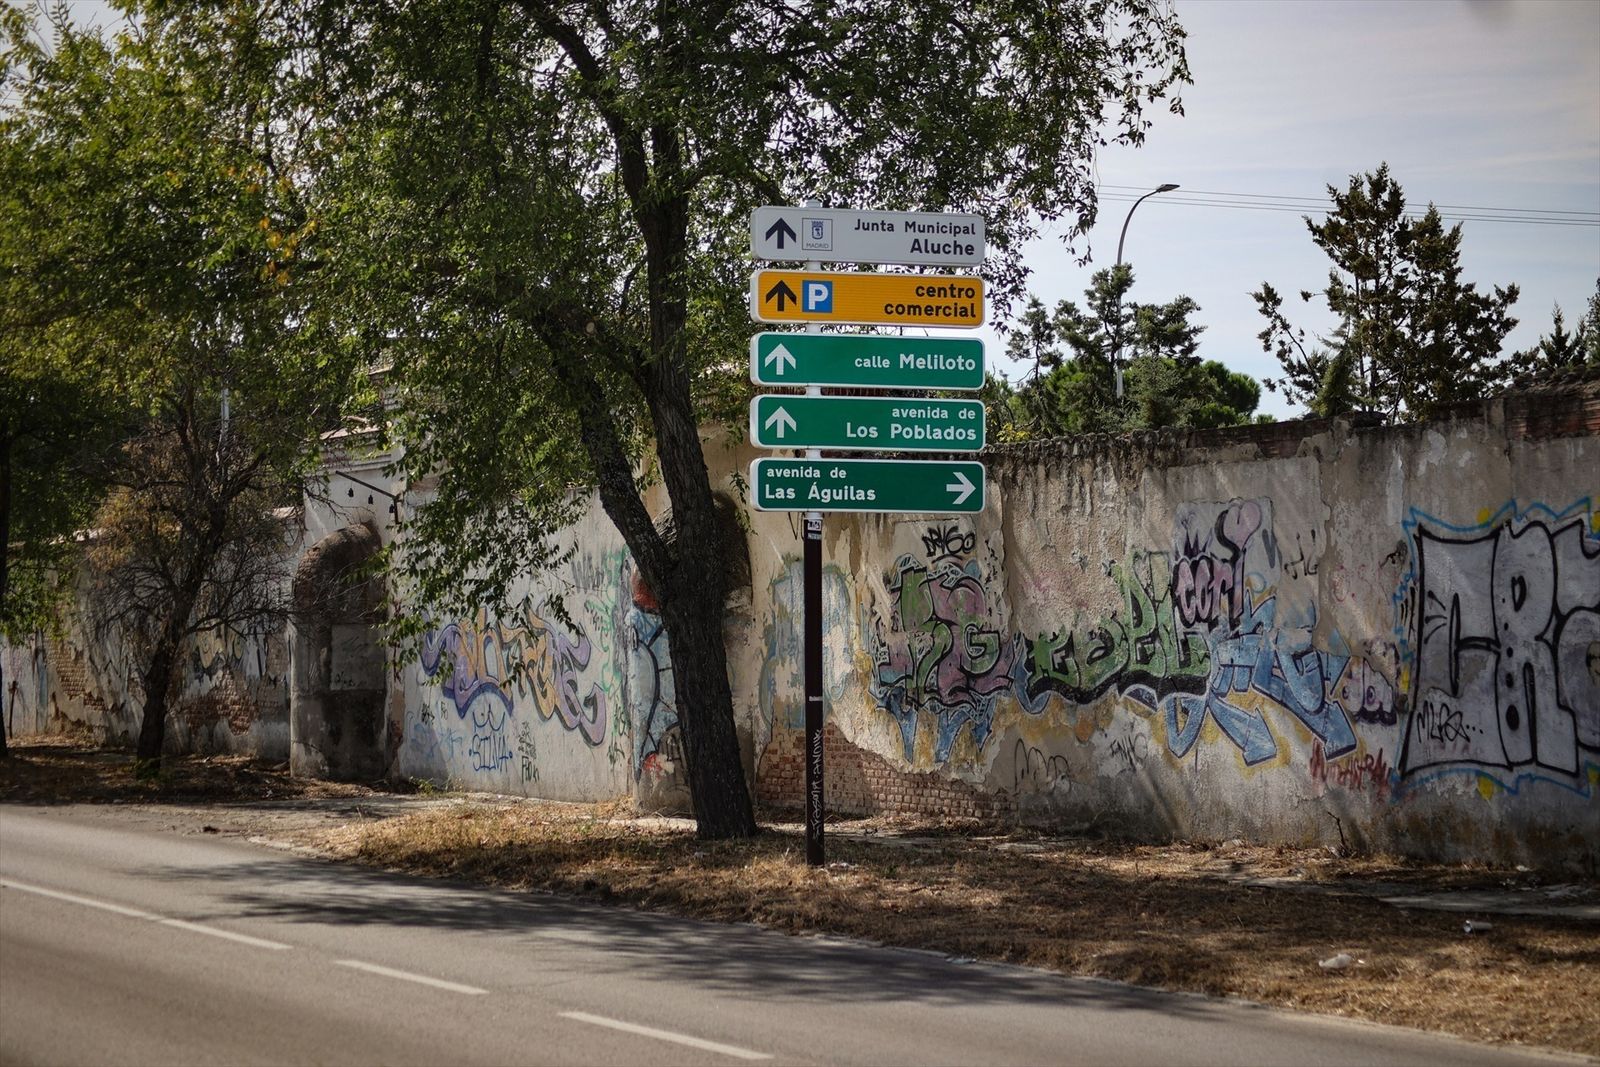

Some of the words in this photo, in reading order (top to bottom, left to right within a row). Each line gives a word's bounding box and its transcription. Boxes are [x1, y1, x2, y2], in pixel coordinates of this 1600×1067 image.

[855, 219, 895, 232] Junta
[905, 221, 975, 236] Municipal
[910, 238, 975, 255] Aluche
[808, 284, 828, 310] P
[915, 283, 975, 298] centro
[884, 302, 976, 317] comercial
[855, 356, 890, 368] calle
[900, 354, 976, 371] Meliloto
[892, 407, 948, 419] avenida
[959, 408, 976, 419] de
[846, 422, 878, 438] Los
[890, 424, 977, 440] Poblados
[767, 466, 821, 478] avenida
[830, 467, 847, 479] de
[765, 484, 795, 499] Las
[808, 482, 876, 502] Águilas
